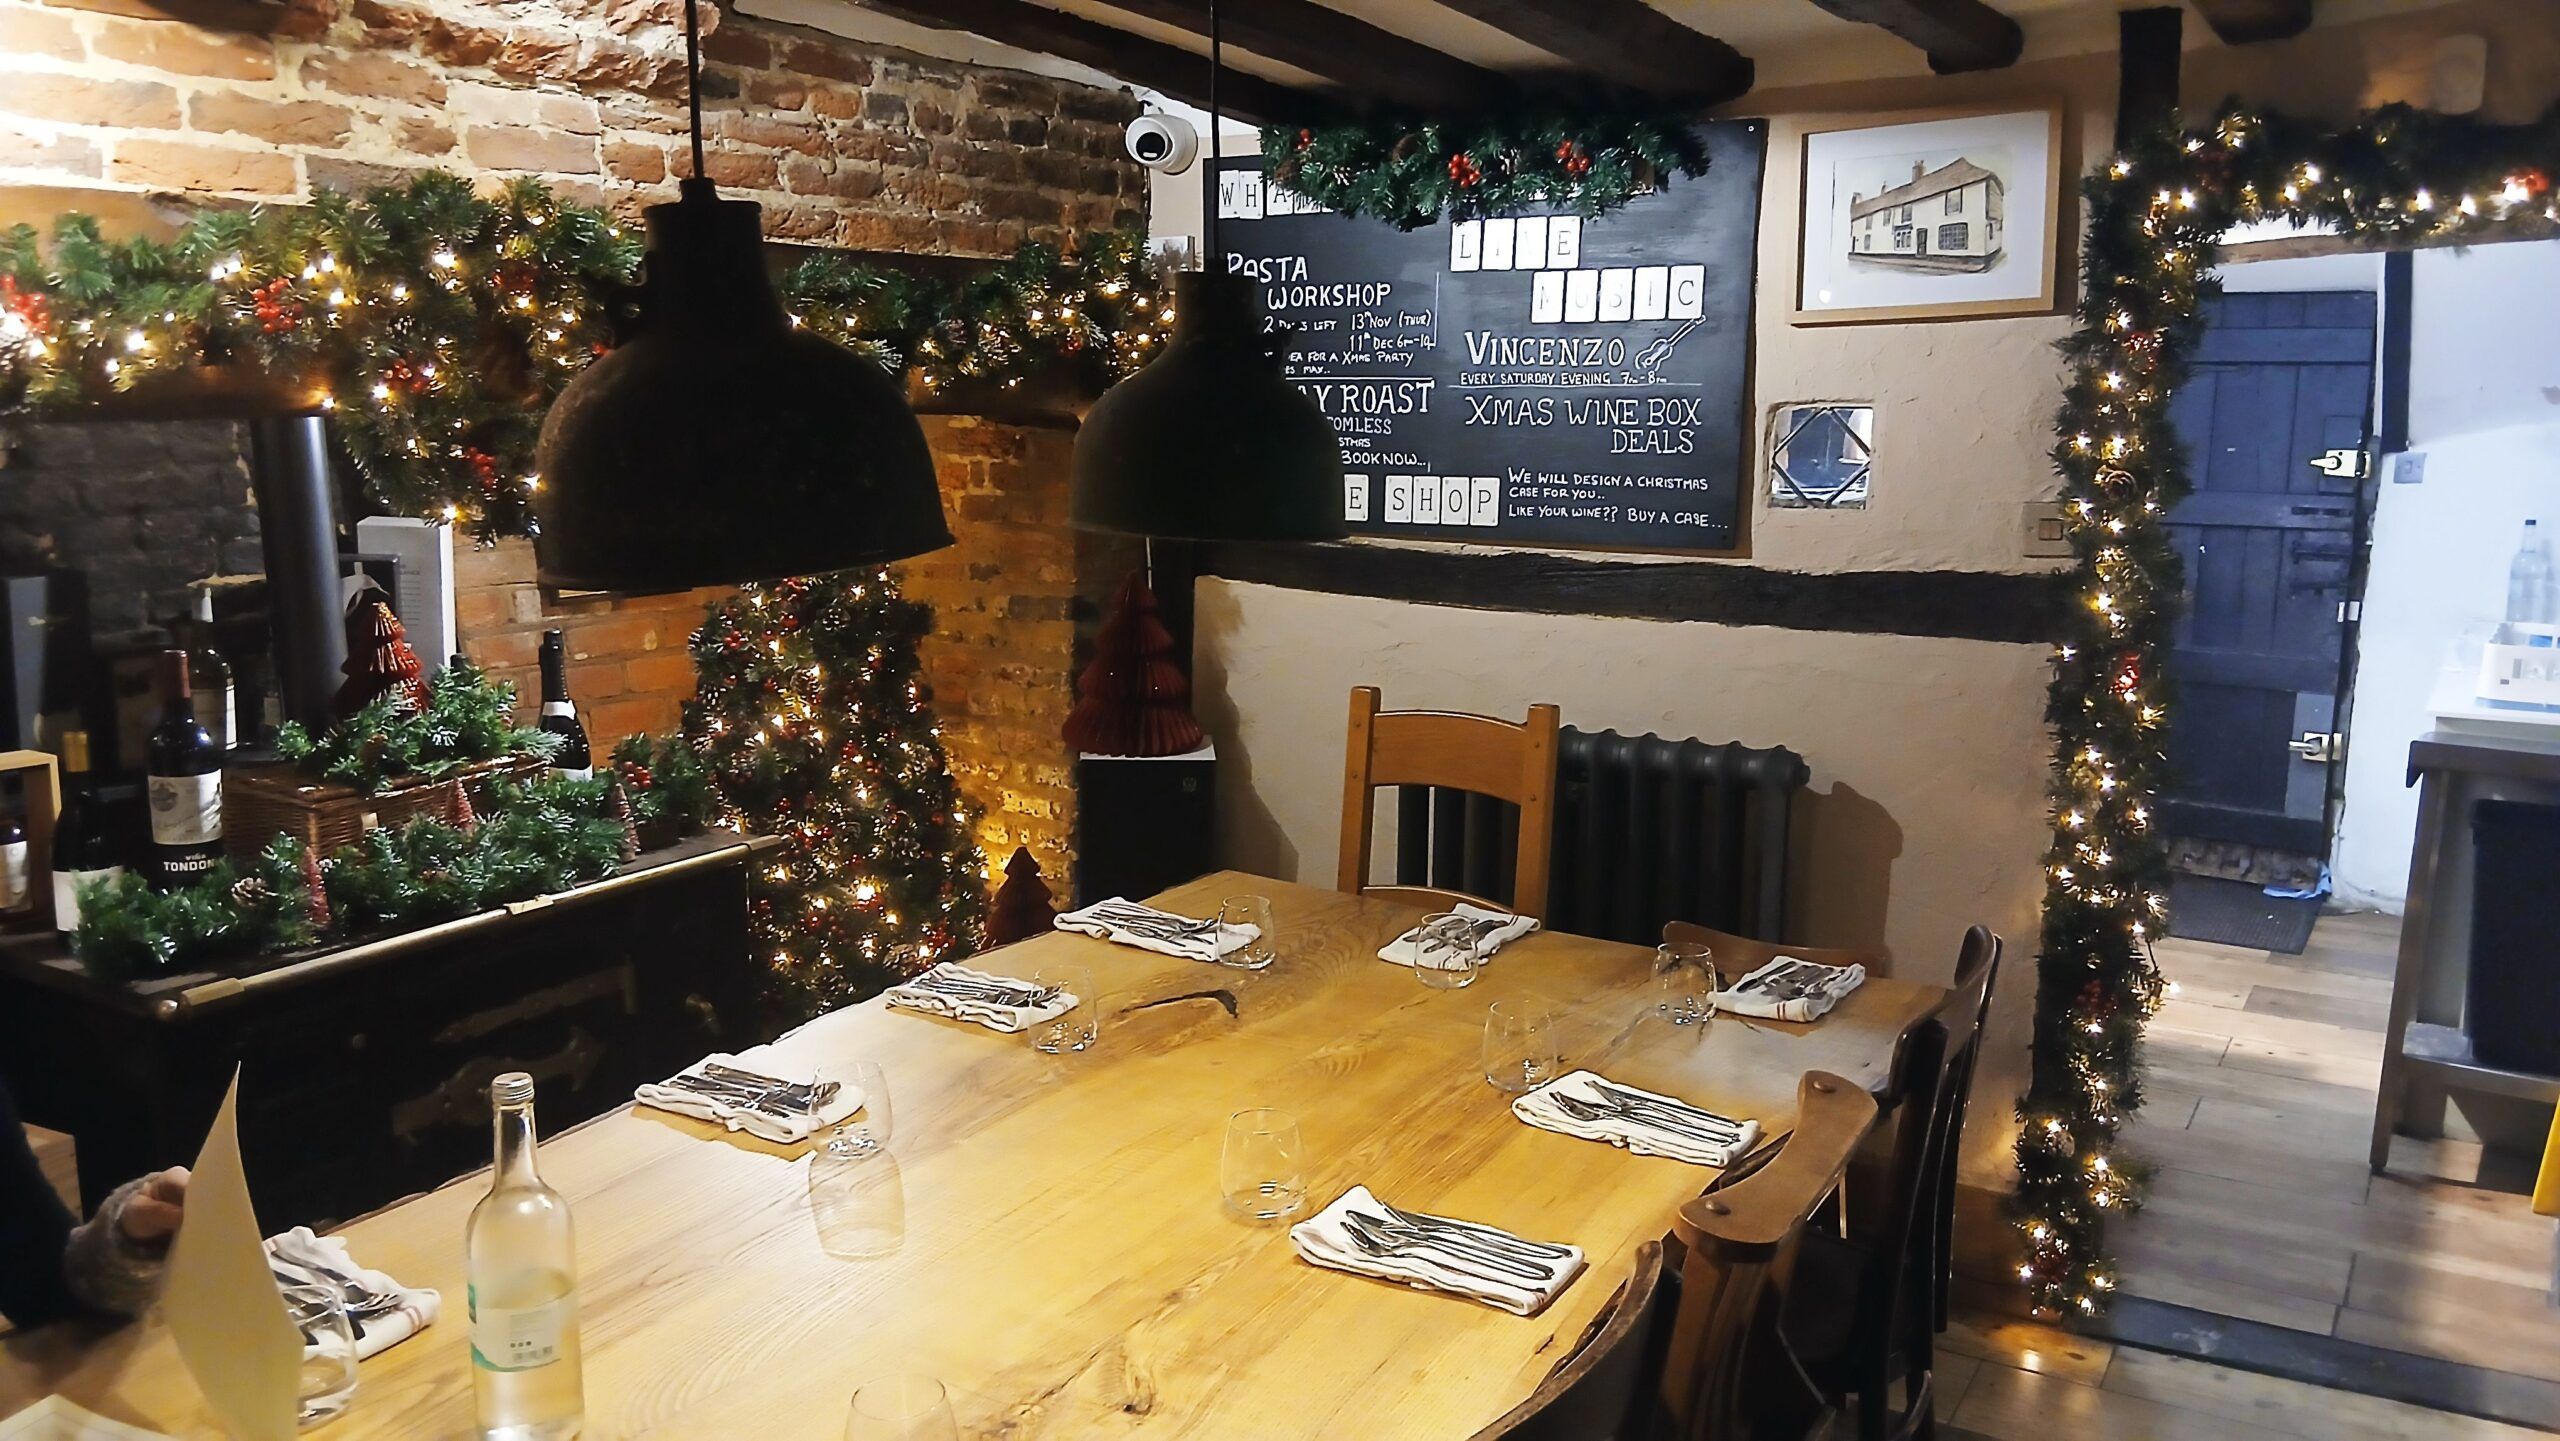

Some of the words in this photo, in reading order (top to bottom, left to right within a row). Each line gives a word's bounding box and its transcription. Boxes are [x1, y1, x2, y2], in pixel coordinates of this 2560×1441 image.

[1227, 252, 1308, 284] PASTA
[1267, 282, 1391, 310] WORKSHOP
[1540, 279, 1695, 310] MUSIC
[1373, 337, 1394, 350] DEC
[1464, 331, 1626, 367] VINCENZO
[1307, 351, 1326, 363] FOR
[1329, 354, 1339, 363] A
[1341, 351, 1371, 365] XMAS
[1377, 352, 1414, 367] PARTY
[1460, 373, 1496, 386] EVERY
[1500, 373, 1556, 386] SATURDAY
[1561, 373, 1611, 386] EVENING
[1340, 380, 1435, 414] ROAST
[1465, 395, 1555, 426] XMAS
[1564, 399, 1639, 426] WINE
[1646, 398, 1702, 426] BOX
[1338, 437, 1372, 448] STMAS
[1610, 429, 1695, 454] DEALS
[1507, 466, 1532, 485] WE
[1538, 472, 1569, 486] WILL
[1574, 474, 1621, 487] DESIGN
[1623, 476, 1634, 488] A
[1637, 475, 1709, 491] CHRISTMAS
[1392, 487, 1492, 514] SHOP
[1509, 487, 1539, 499] CASE
[1543, 487, 1569, 499] FOR
[1508, 504, 1535, 518] LIKE
[1538, 505, 1569, 518] YOUR
[1627, 507, 1655, 524] BUY
[1659, 512, 1670, 524] A
[163, 859, 215, 872] TONDON
